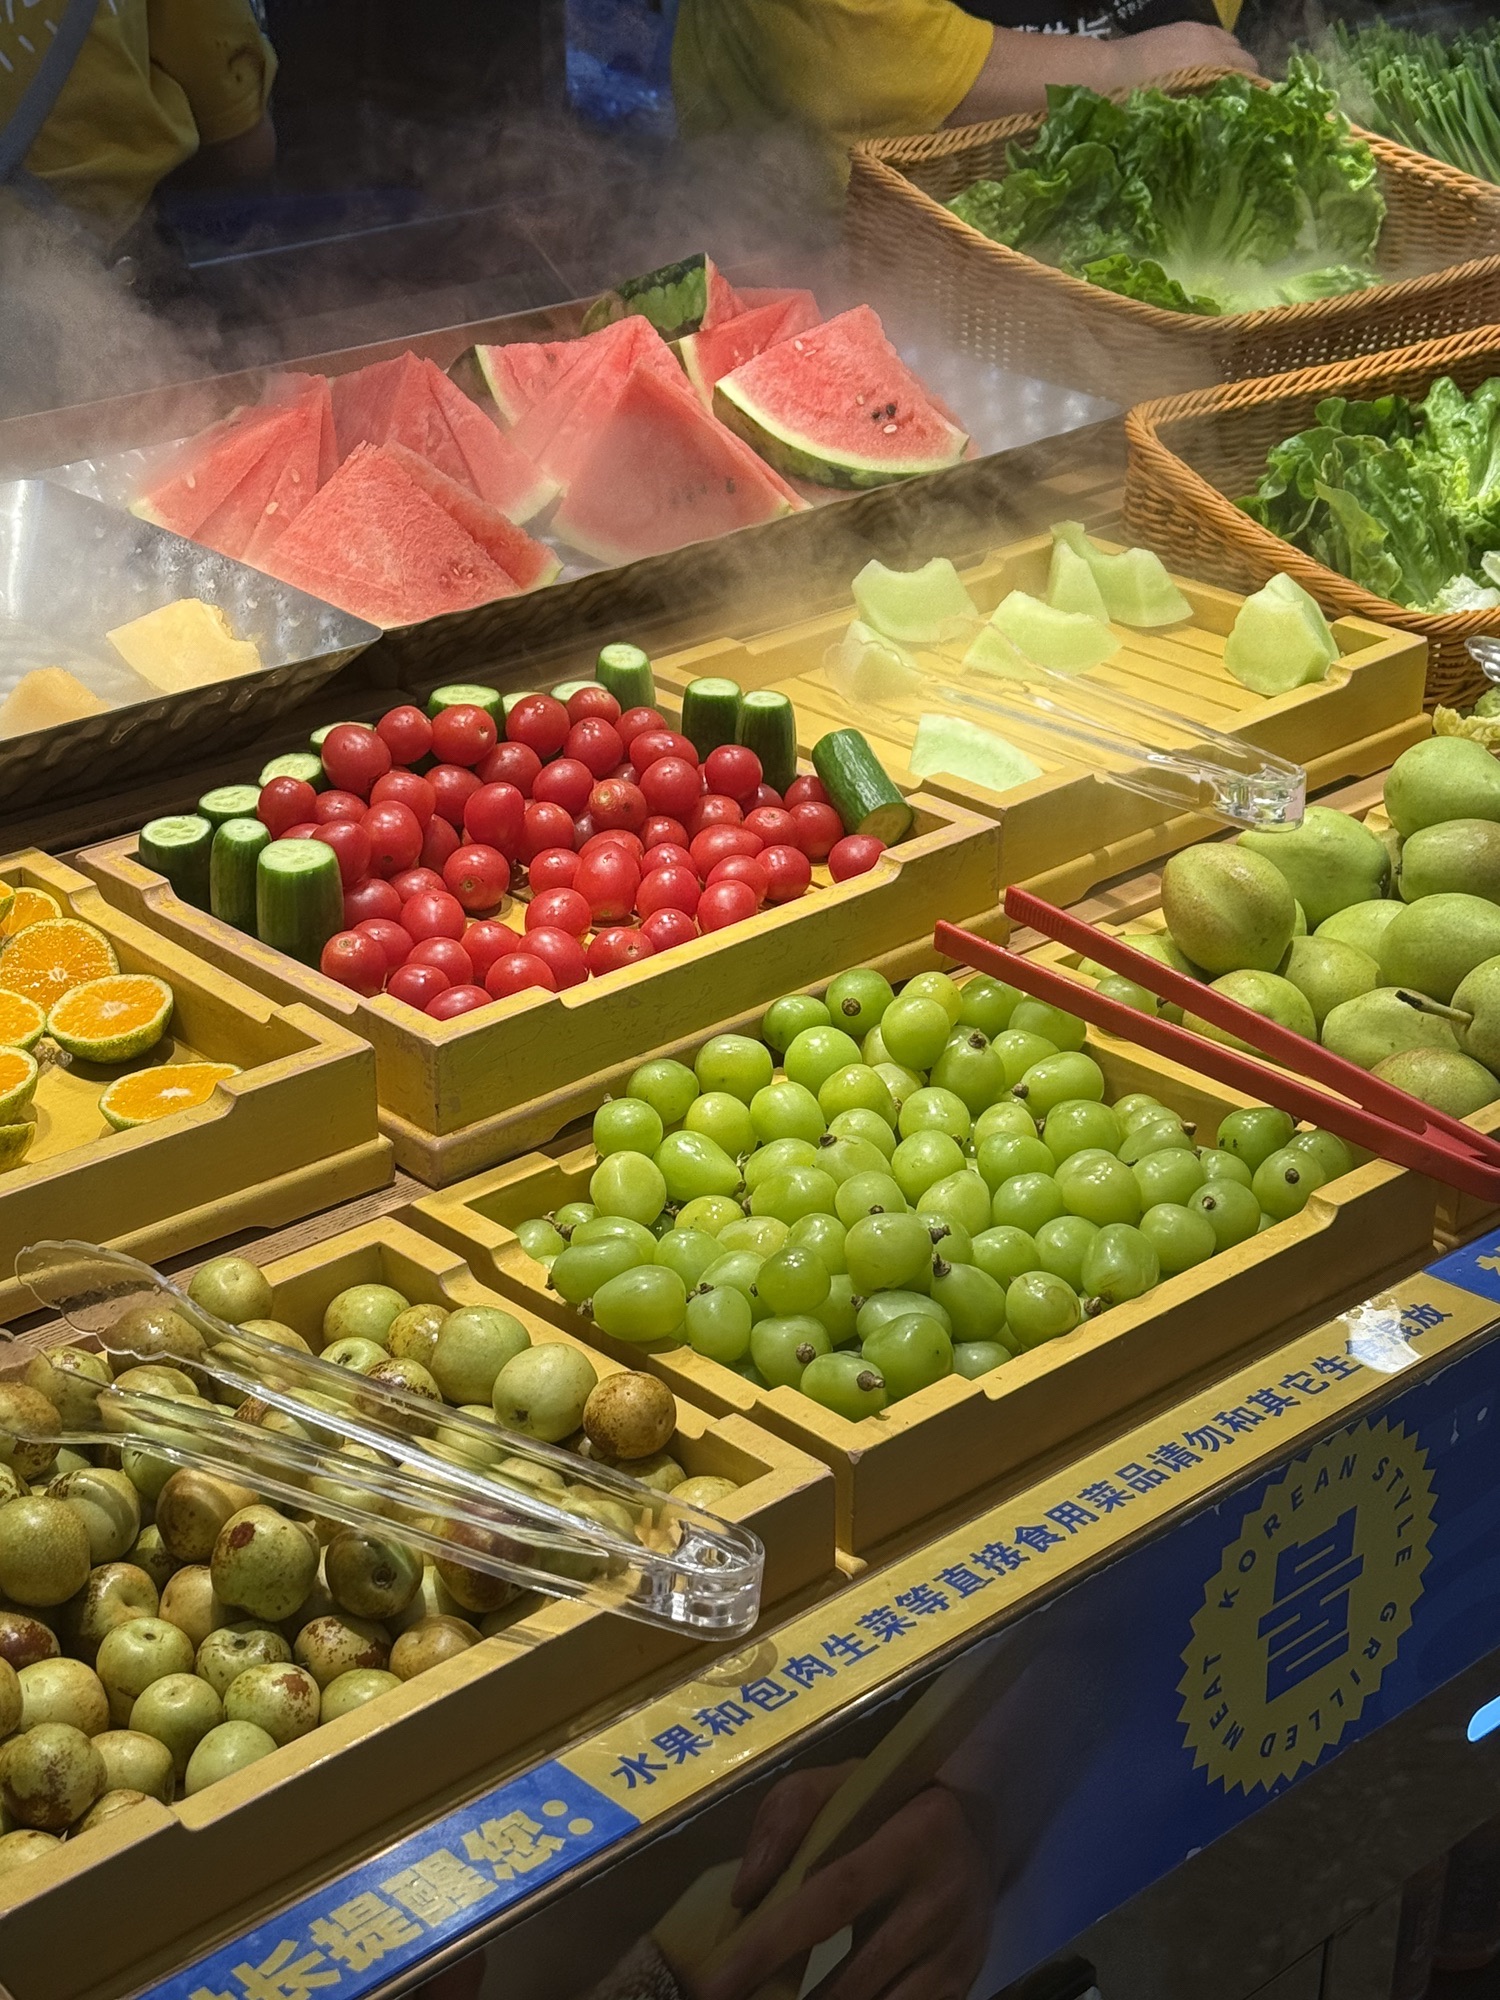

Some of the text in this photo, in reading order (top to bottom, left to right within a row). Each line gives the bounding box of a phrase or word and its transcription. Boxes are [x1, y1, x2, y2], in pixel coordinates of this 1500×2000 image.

[1203, 1453, 1415, 1758] KOREAN STYLE GRILLED MEAT
[187, 1799, 594, 2000] 长提醒您：
